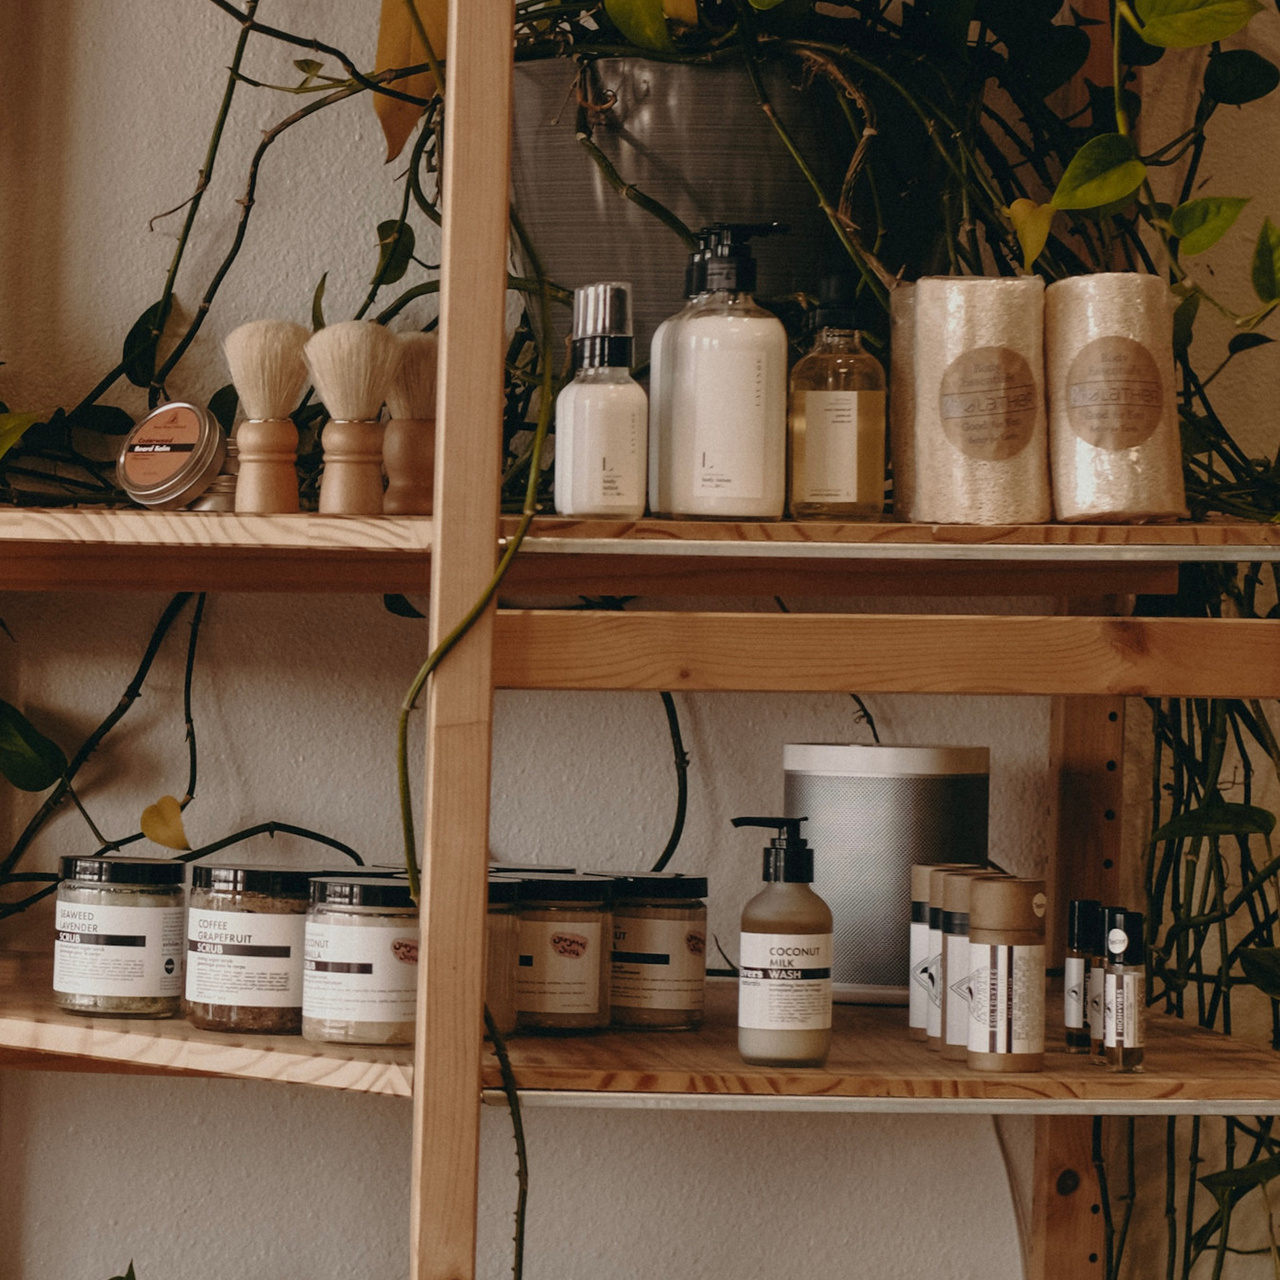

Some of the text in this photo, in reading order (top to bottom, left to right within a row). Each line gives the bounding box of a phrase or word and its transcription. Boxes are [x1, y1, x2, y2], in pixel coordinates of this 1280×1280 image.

[60, 909, 94, 921] SEAWEED
[59, 921, 99, 932] LAVENDER
[198, 919, 228, 931] COFFEE
[59, 932, 81, 943] SCRUB
[197, 931, 252, 943] GRAPEFRUIT
[197, 942, 224, 953] SCRUB
[769, 947, 820, 956] COCONUT
[769, 959, 794, 967] MILK
[768, 969, 802, 979] WASH
